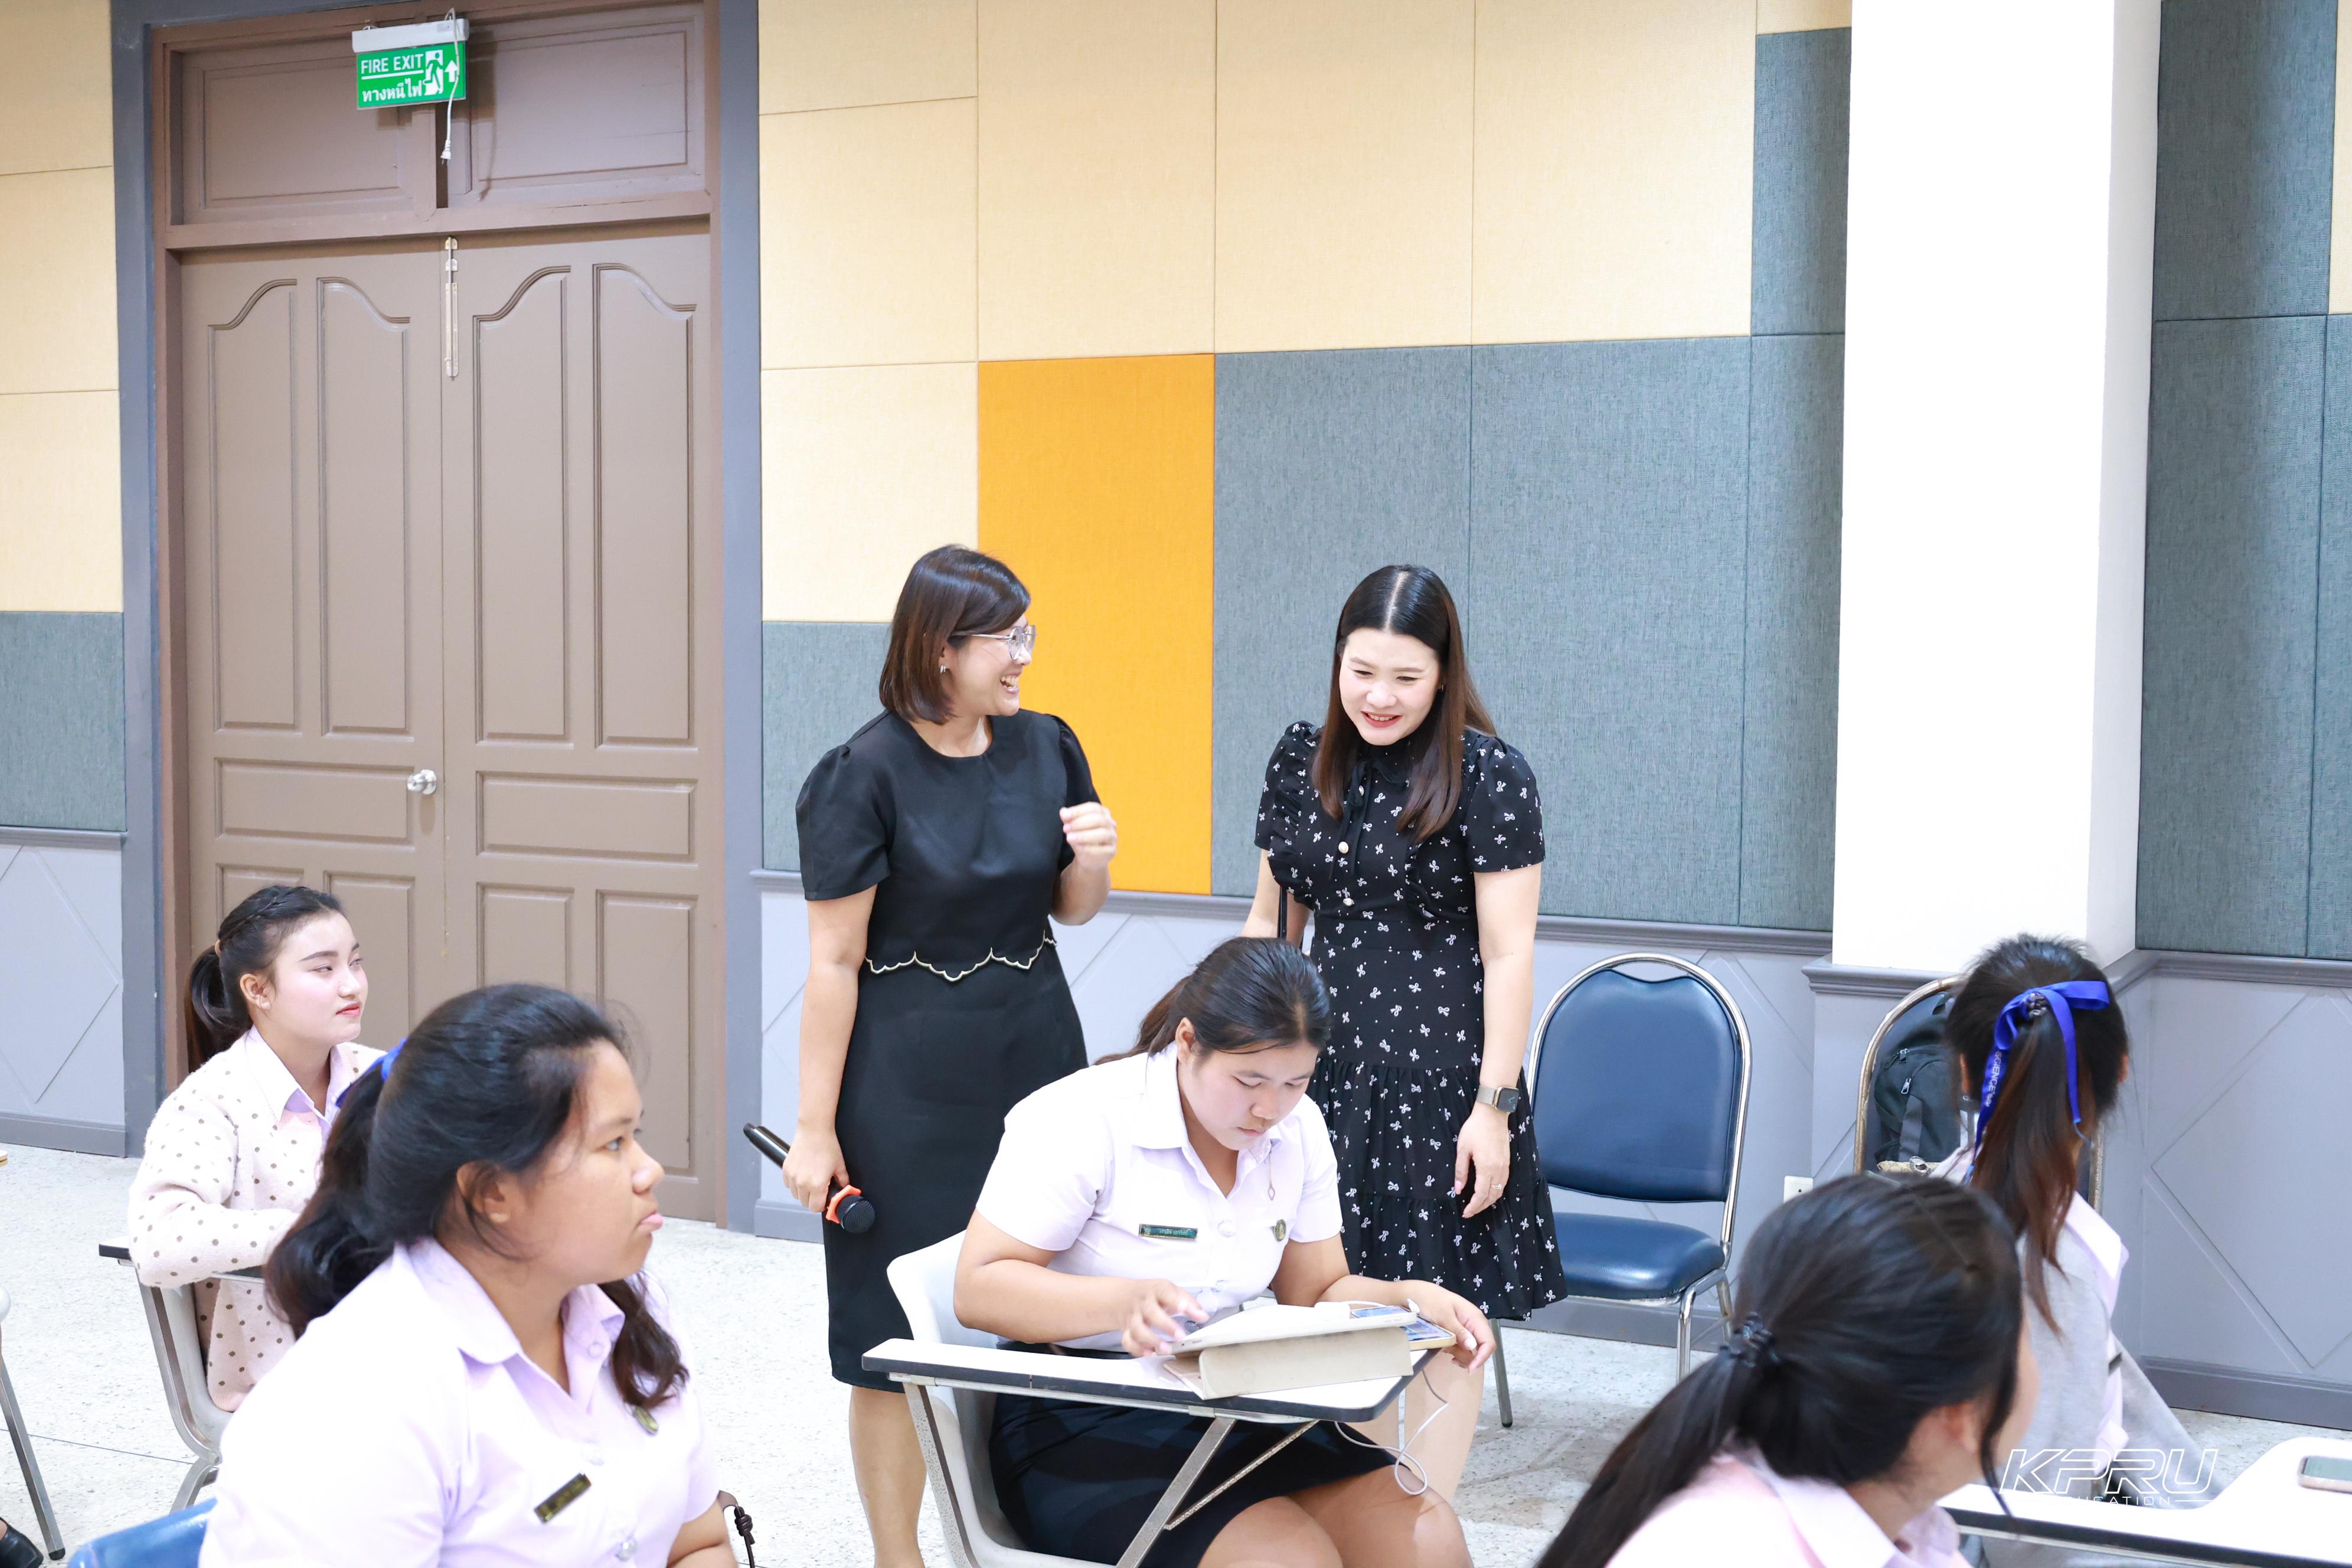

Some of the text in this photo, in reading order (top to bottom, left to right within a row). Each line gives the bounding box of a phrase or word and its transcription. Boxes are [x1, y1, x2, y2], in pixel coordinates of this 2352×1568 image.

[361, 54, 424, 74] FIRE EXIT
[362, 77, 422, 102] ทางหนีไฟ
